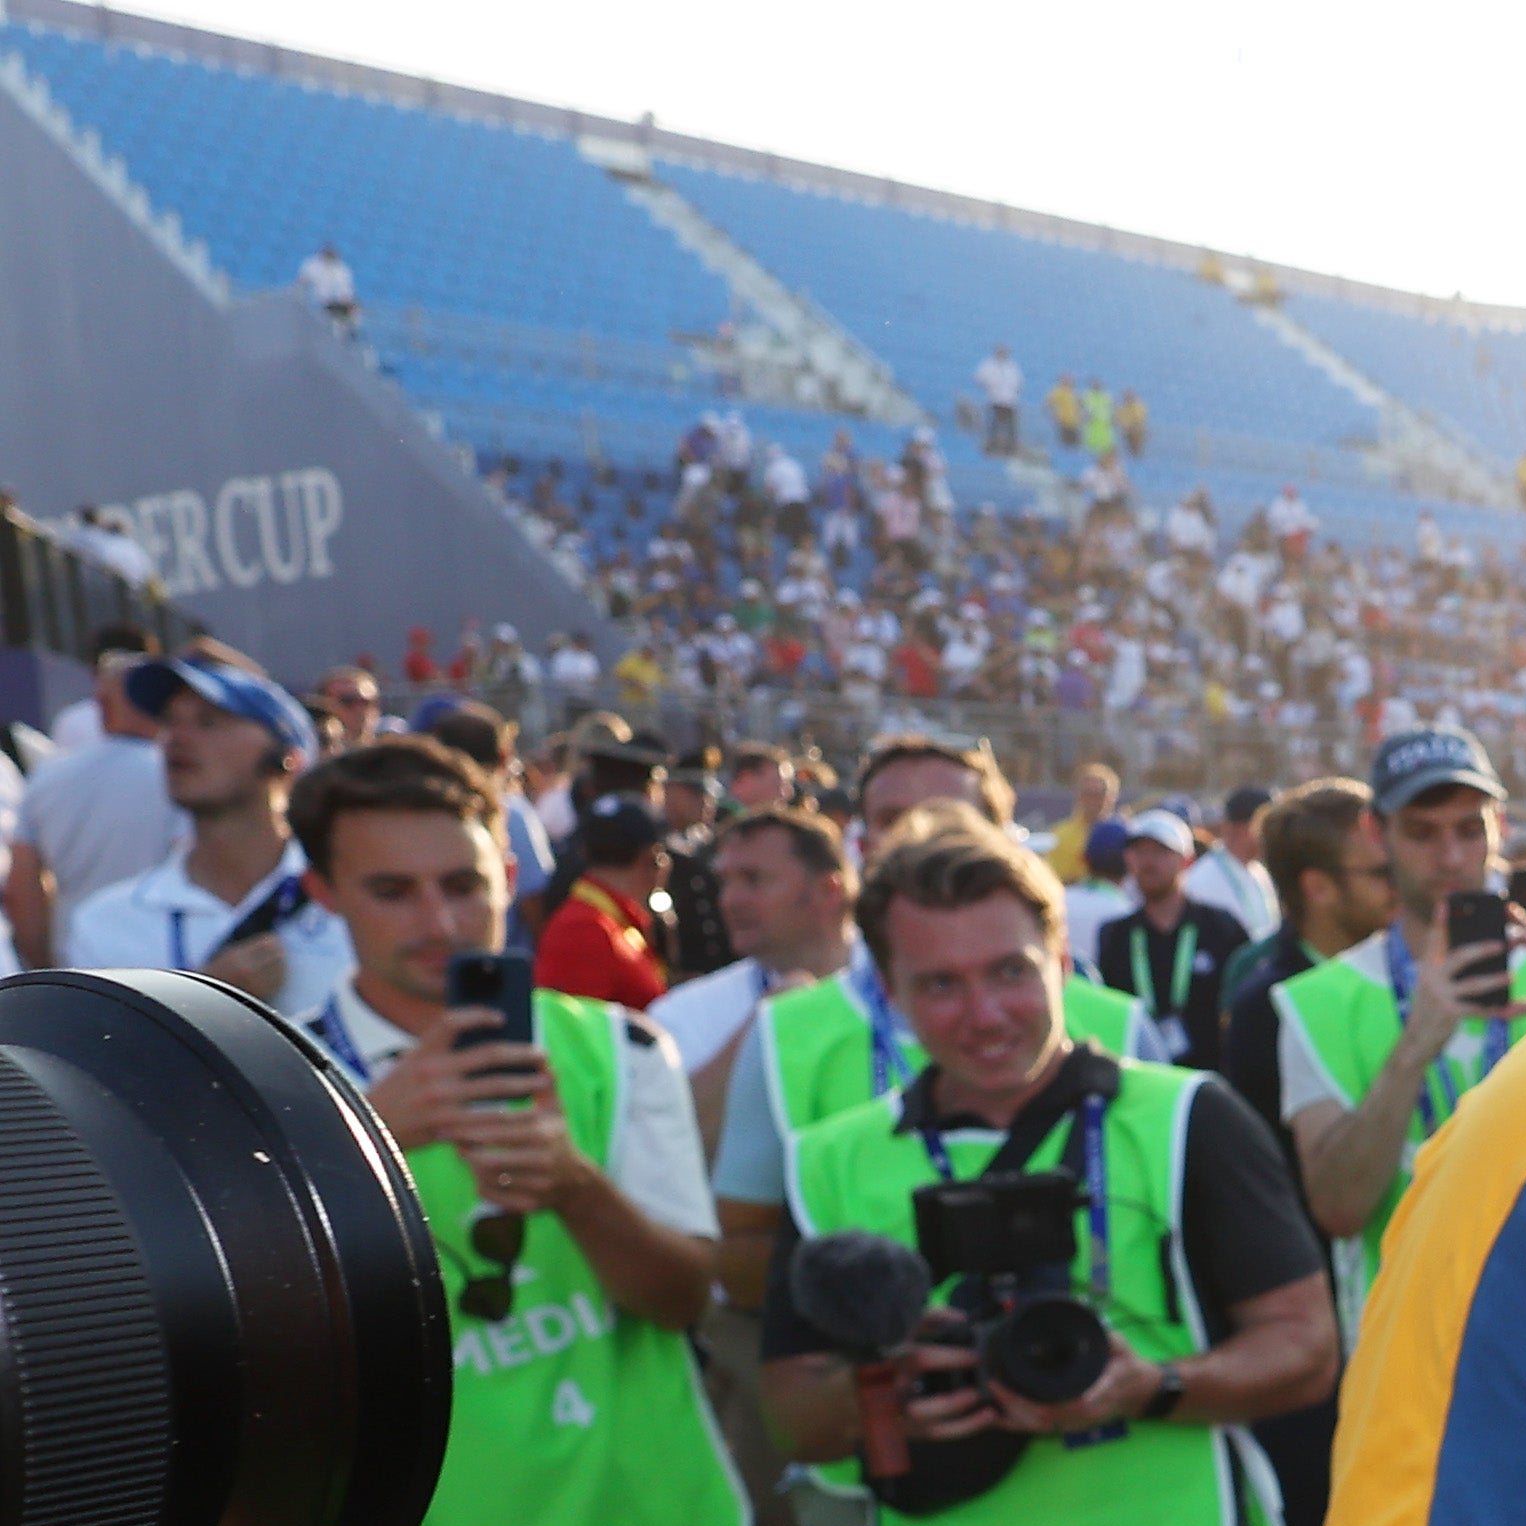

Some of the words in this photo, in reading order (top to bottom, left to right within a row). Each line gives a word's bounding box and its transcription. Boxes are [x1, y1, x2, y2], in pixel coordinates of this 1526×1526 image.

[215, 466, 343, 588] CUP
[452, 1294, 616, 1376] MEDI
[553, 1379, 594, 1428] 4
